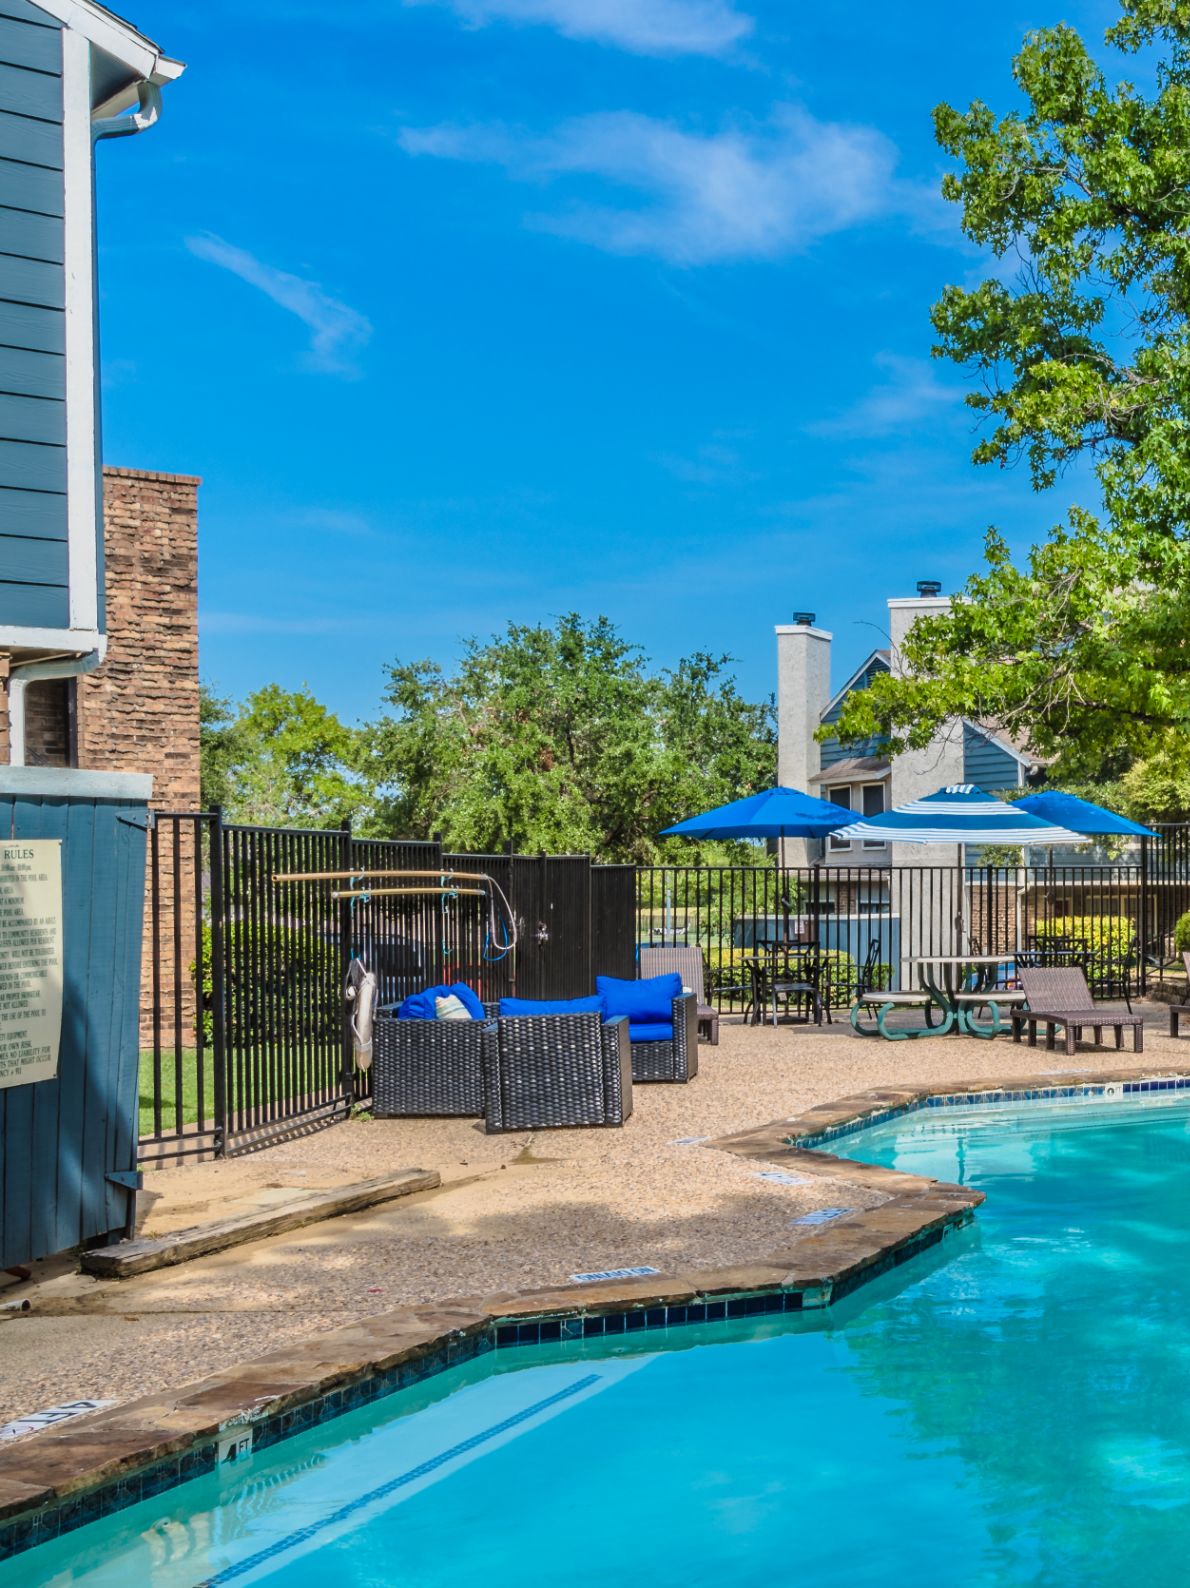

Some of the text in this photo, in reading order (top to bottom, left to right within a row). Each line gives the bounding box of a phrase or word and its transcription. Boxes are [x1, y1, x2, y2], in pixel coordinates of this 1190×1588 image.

[4, 849, 34, 859] RULES
[575, 1269, 632, 1281] DIVING
[17, 1412, 78, 1425] FT
[239, 1437, 250, 1453] FT
